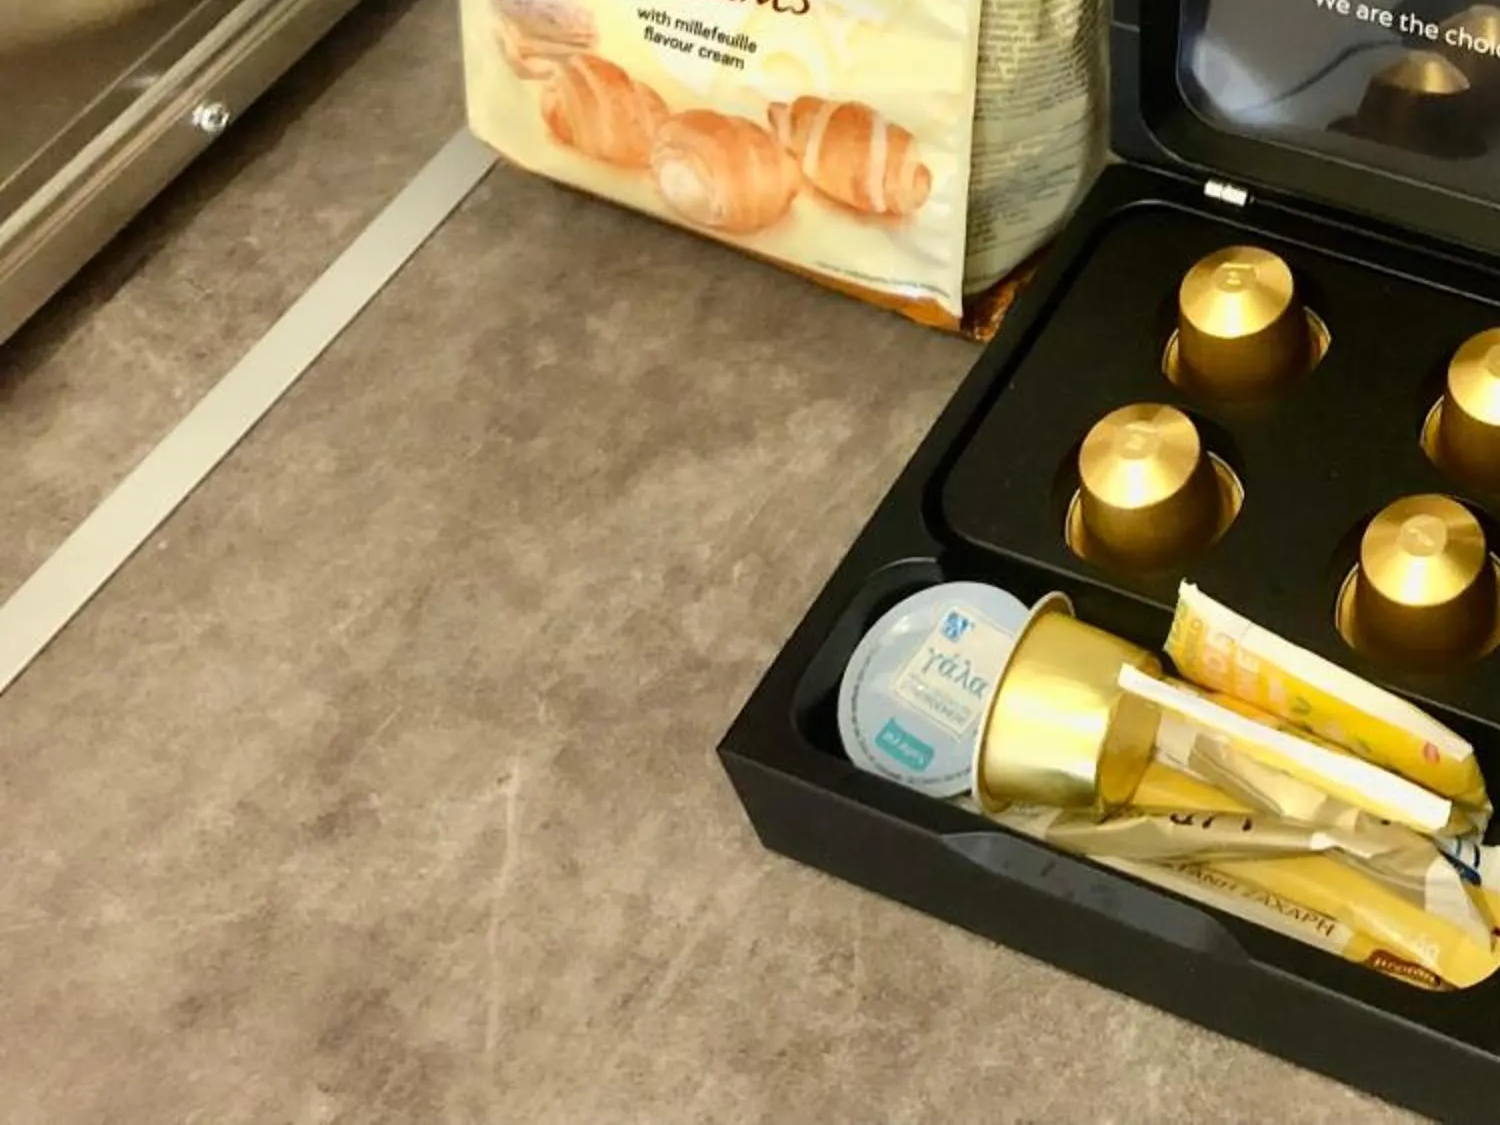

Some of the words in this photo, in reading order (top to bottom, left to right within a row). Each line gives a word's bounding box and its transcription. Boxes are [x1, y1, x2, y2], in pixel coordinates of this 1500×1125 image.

[637, 8, 671, 27] with
[675, 18, 757, 54] millefeuille
[1356, 3, 1393, 28] are
[1399, 12, 1440, 40] the
[643, 25, 694, 53] flavour
[698, 47, 745, 70] cream
